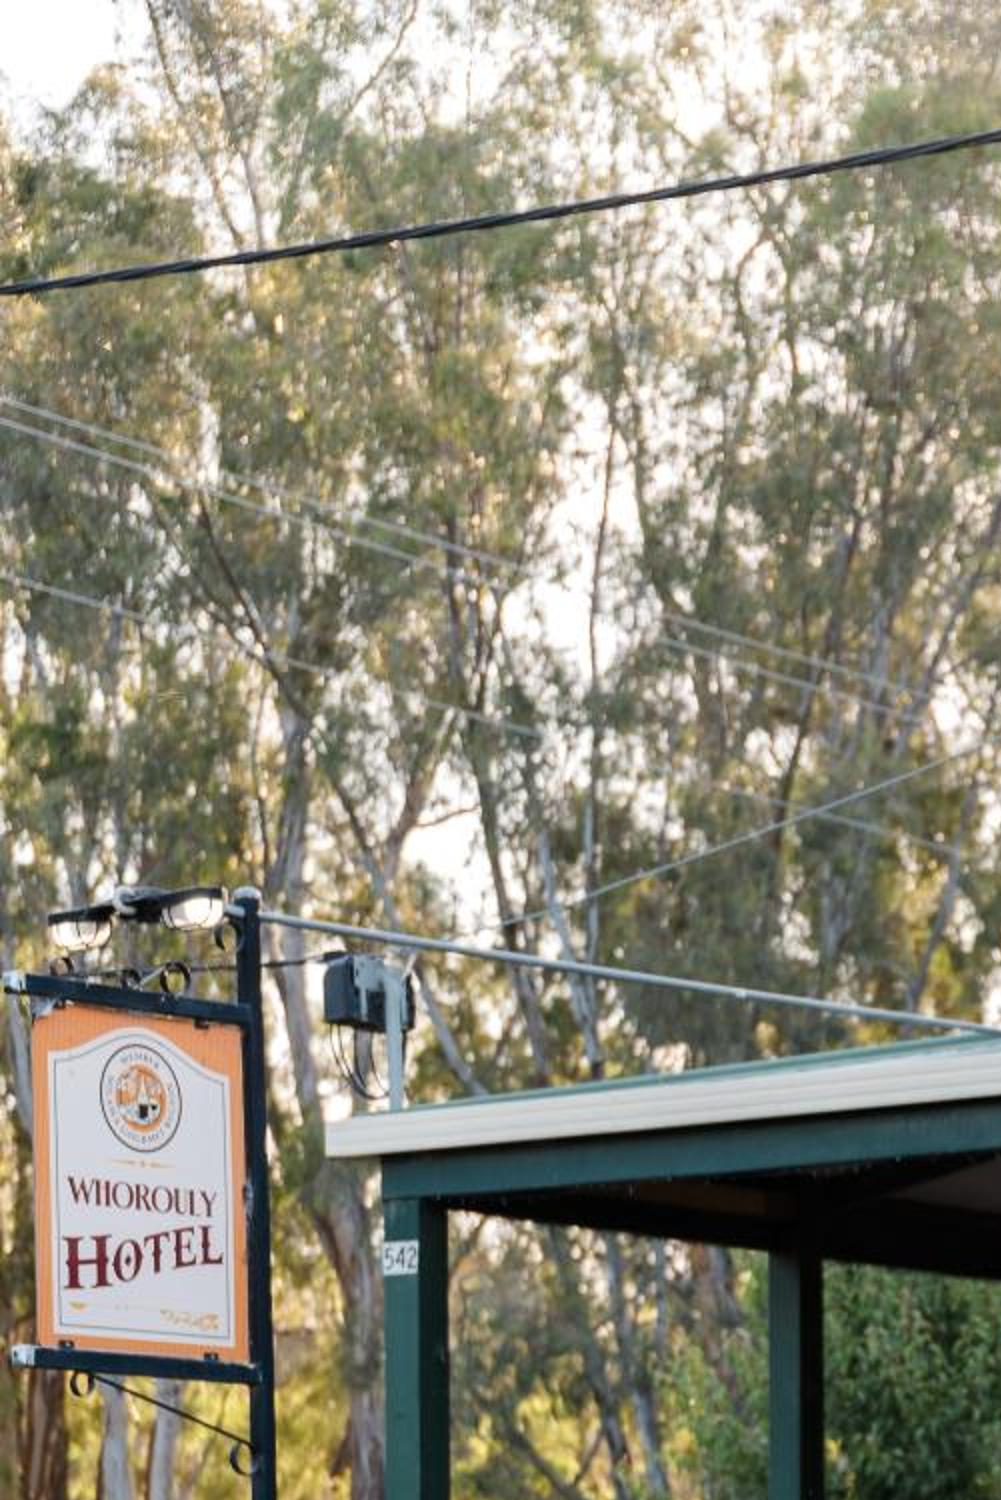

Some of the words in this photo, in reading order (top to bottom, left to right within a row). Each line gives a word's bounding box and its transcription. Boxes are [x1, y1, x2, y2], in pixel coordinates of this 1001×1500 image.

[67, 1176, 219, 1219] WHOROULY
[63, 1225, 224, 1290] HOTEL
[384, 1245, 417, 1271] 542
